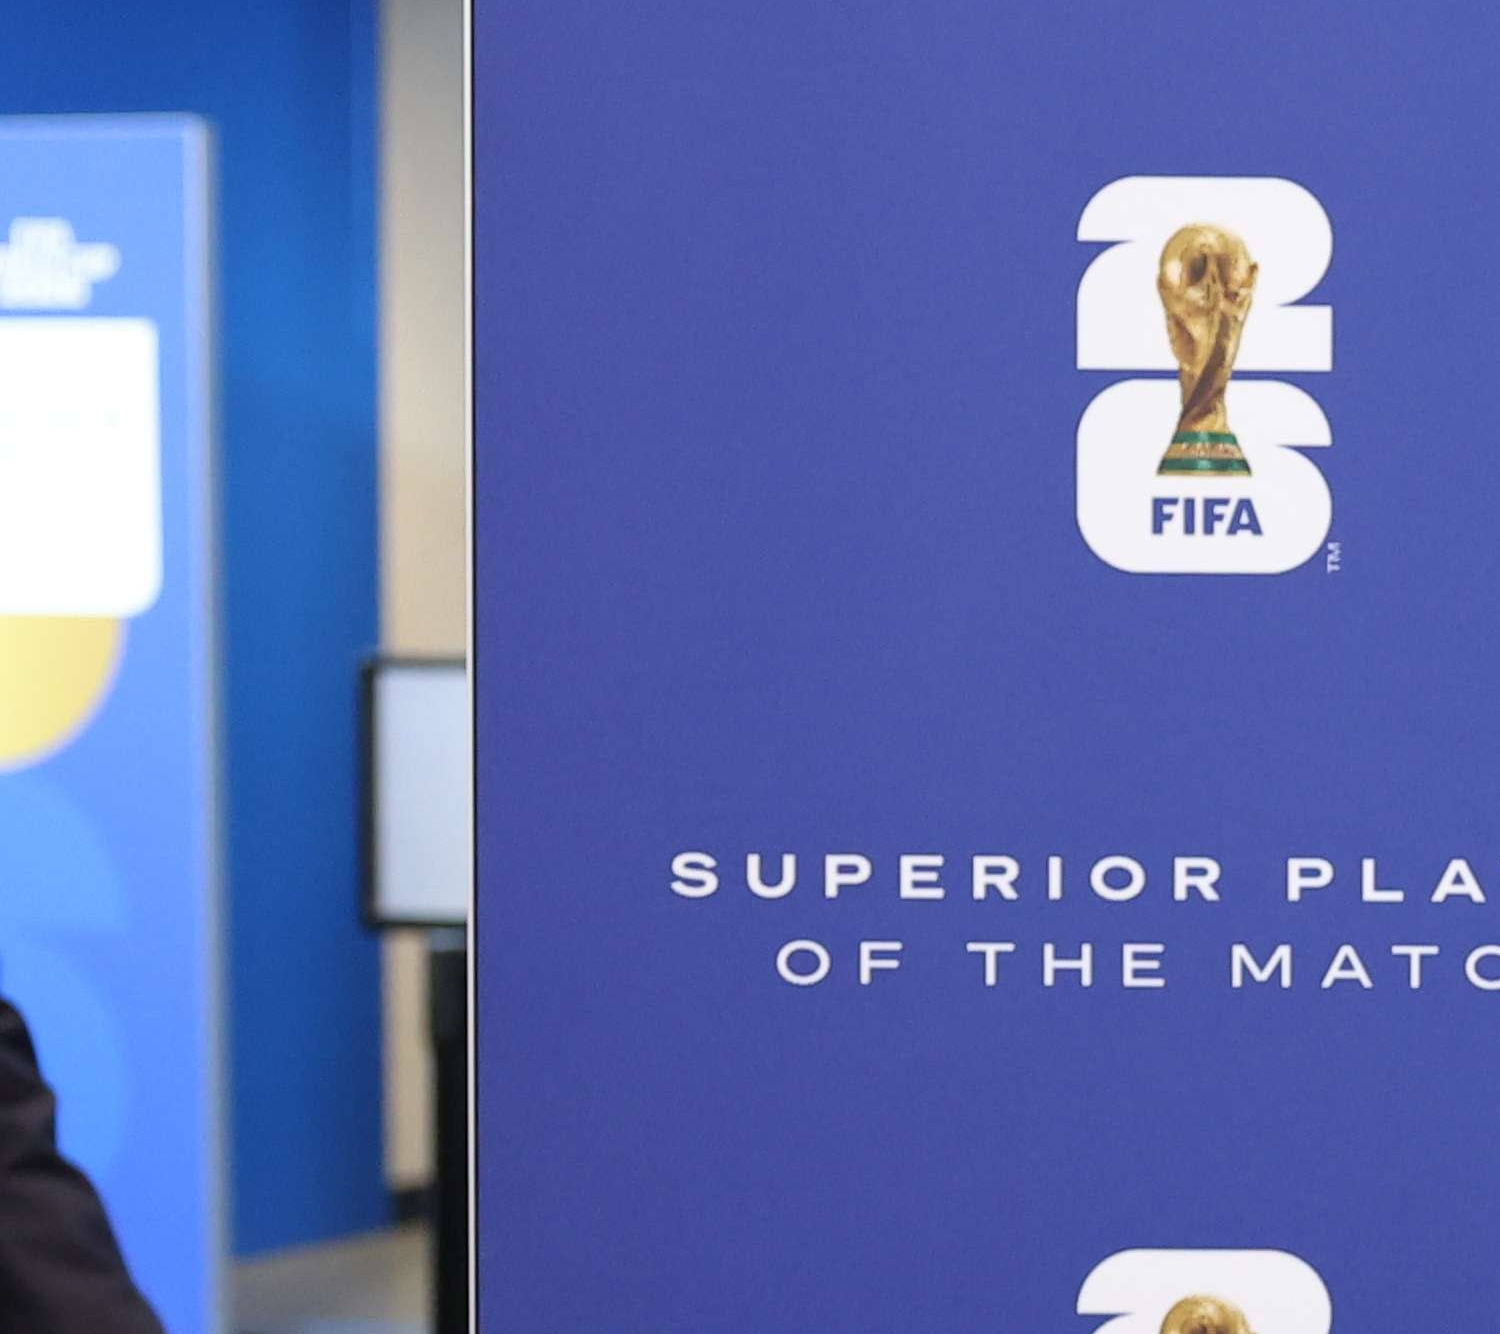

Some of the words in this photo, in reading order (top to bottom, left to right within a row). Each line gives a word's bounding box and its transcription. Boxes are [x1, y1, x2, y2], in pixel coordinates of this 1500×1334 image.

[1151, 496, 1263, 537] FIFA
[670, 852, 1221, 902] SUPERIOR
[776, 939, 903, 986] OF
[966, 942, 1166, 988] THE
